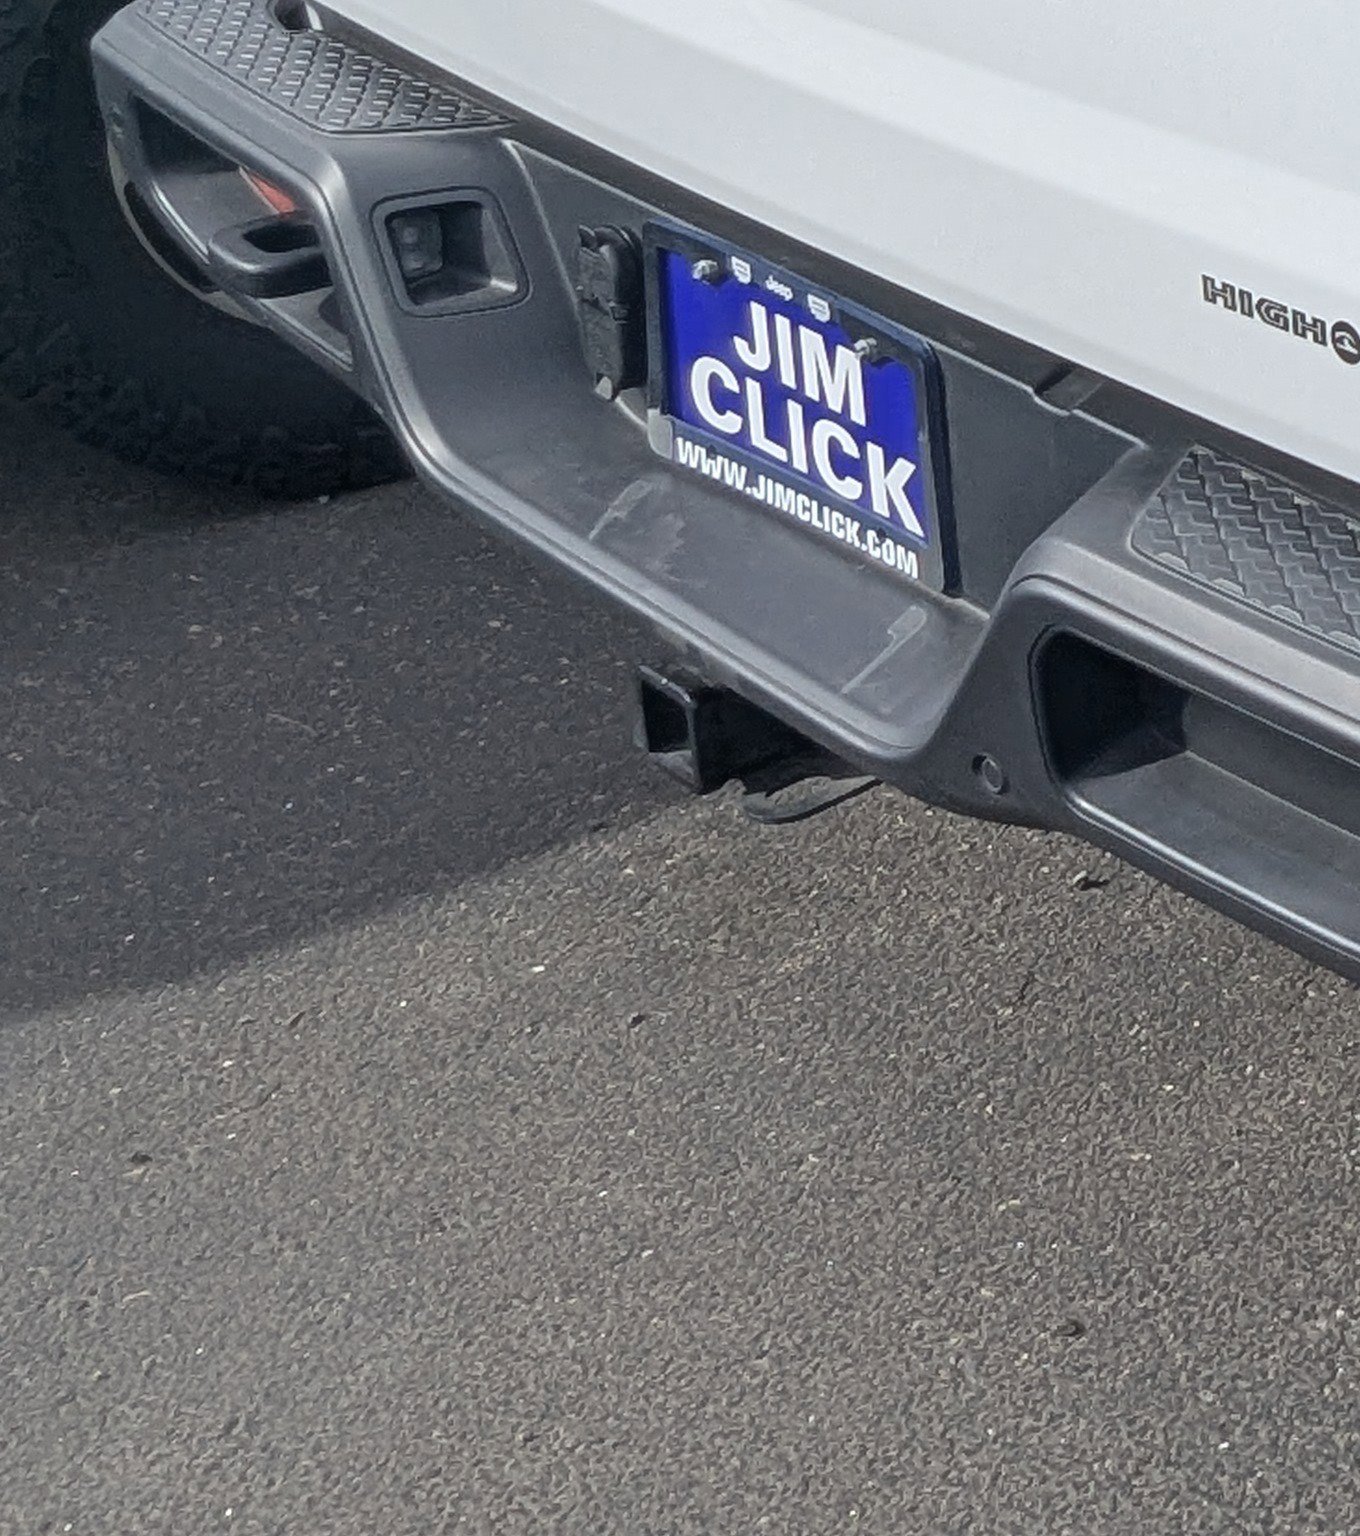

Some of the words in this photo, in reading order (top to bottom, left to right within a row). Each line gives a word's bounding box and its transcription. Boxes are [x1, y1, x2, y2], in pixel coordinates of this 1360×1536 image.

[733, 300, 866, 427] JIM
[1201, 274, 1329, 347] HIGH
[675, 436, 919, 580] WWW.JIMCLICK.COM
[690, 355, 925, 538] CLICK
